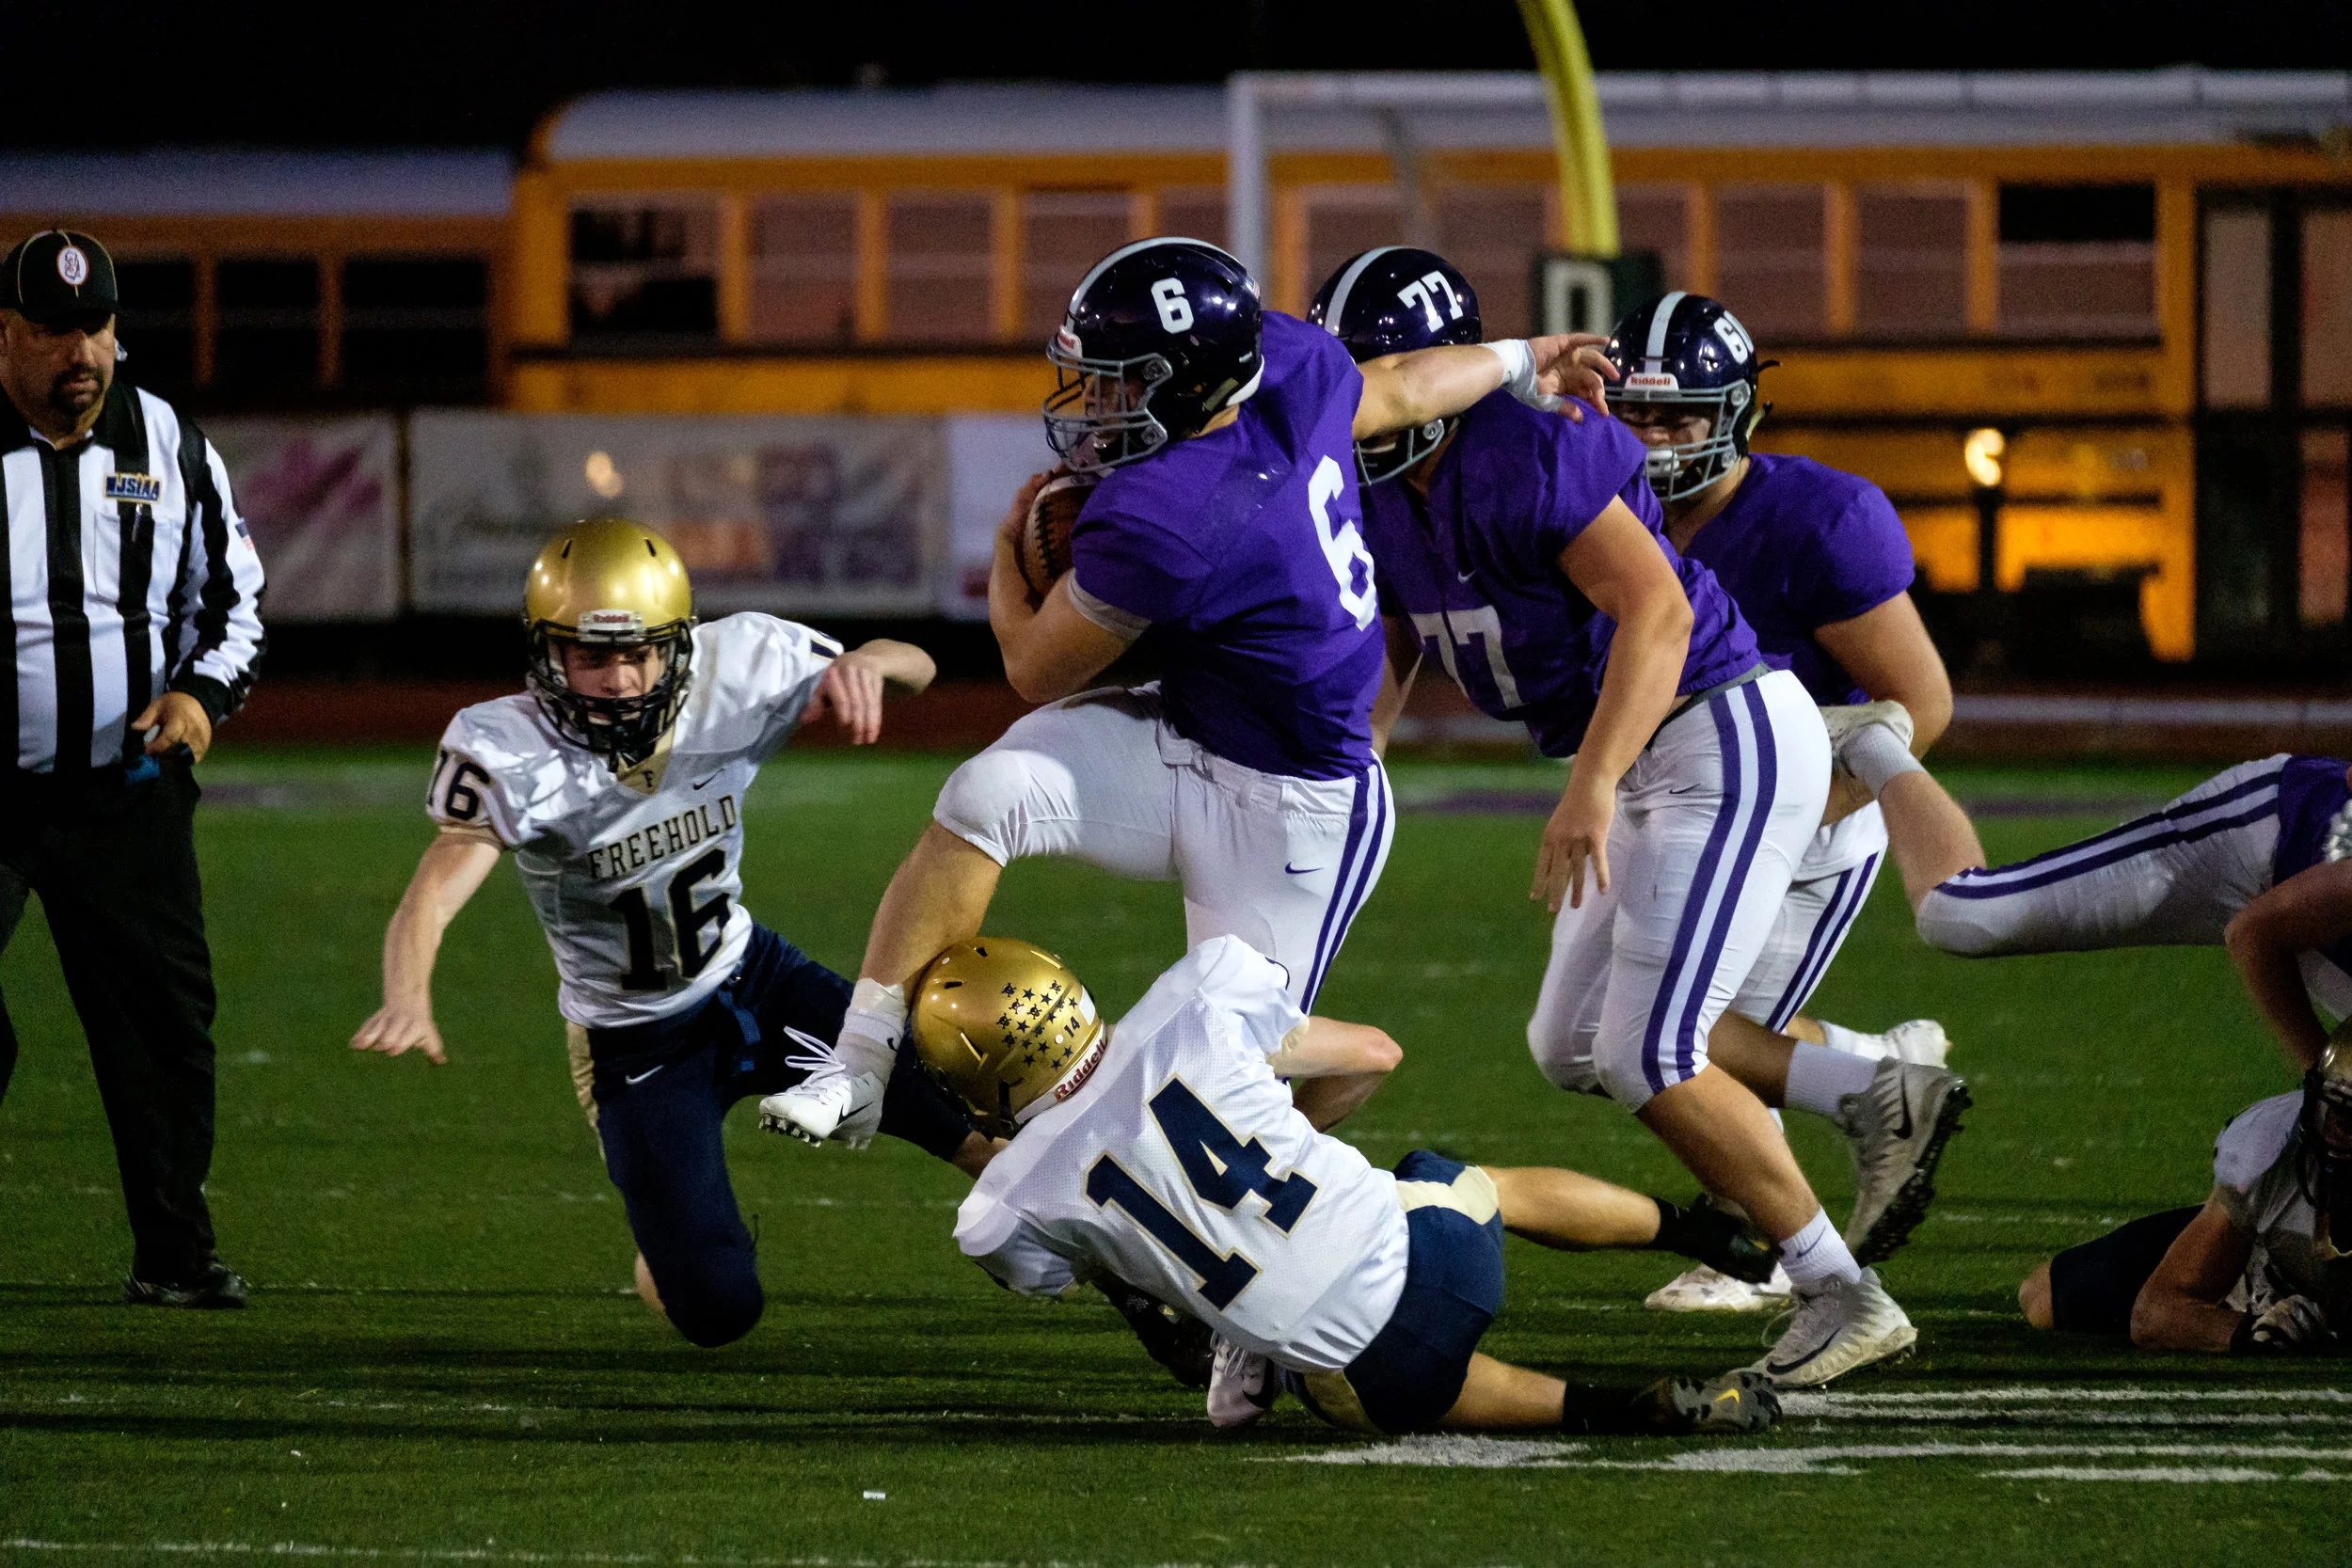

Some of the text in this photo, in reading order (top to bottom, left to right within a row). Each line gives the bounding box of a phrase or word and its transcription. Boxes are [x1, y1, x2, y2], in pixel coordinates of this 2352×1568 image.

[1151, 277, 1194, 334] 6
[1397, 271, 1463, 333] 77
[1308, 454, 1376, 631] 6
[1409, 606, 1523, 709] 77
[428, 750, 491, 821] 16
[643, 768, 656, 789] F
[587, 794, 737, 879] FREEHOLD
[610, 847, 733, 991] 16
[1064, 1016, 1080, 1037] 14
[1055, 1037, 1108, 1101] Riddell
[1083, 1073, 1318, 1311] 14
